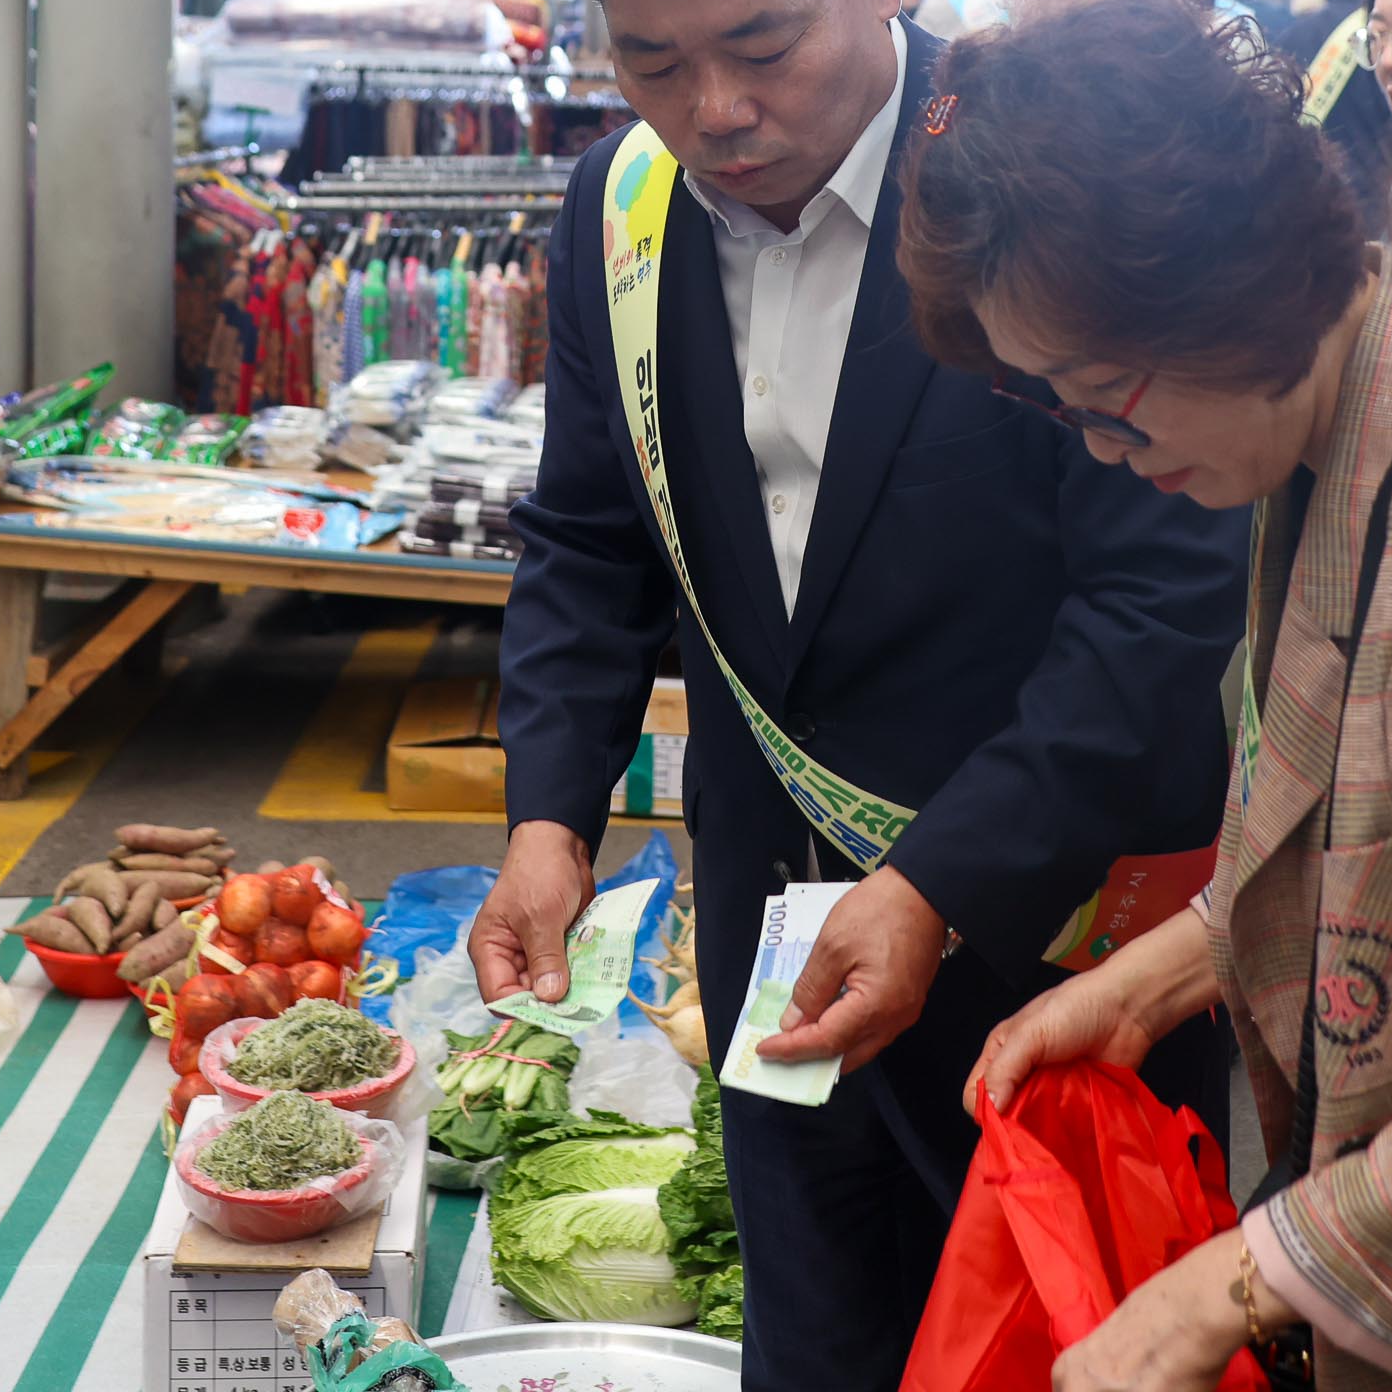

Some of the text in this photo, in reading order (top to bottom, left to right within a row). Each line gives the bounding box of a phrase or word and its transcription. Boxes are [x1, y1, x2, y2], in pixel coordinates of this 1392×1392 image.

[637, 259, 652, 284] 영주
[636, 349, 660, 471] 인심
[764, 900, 788, 947] 1000
